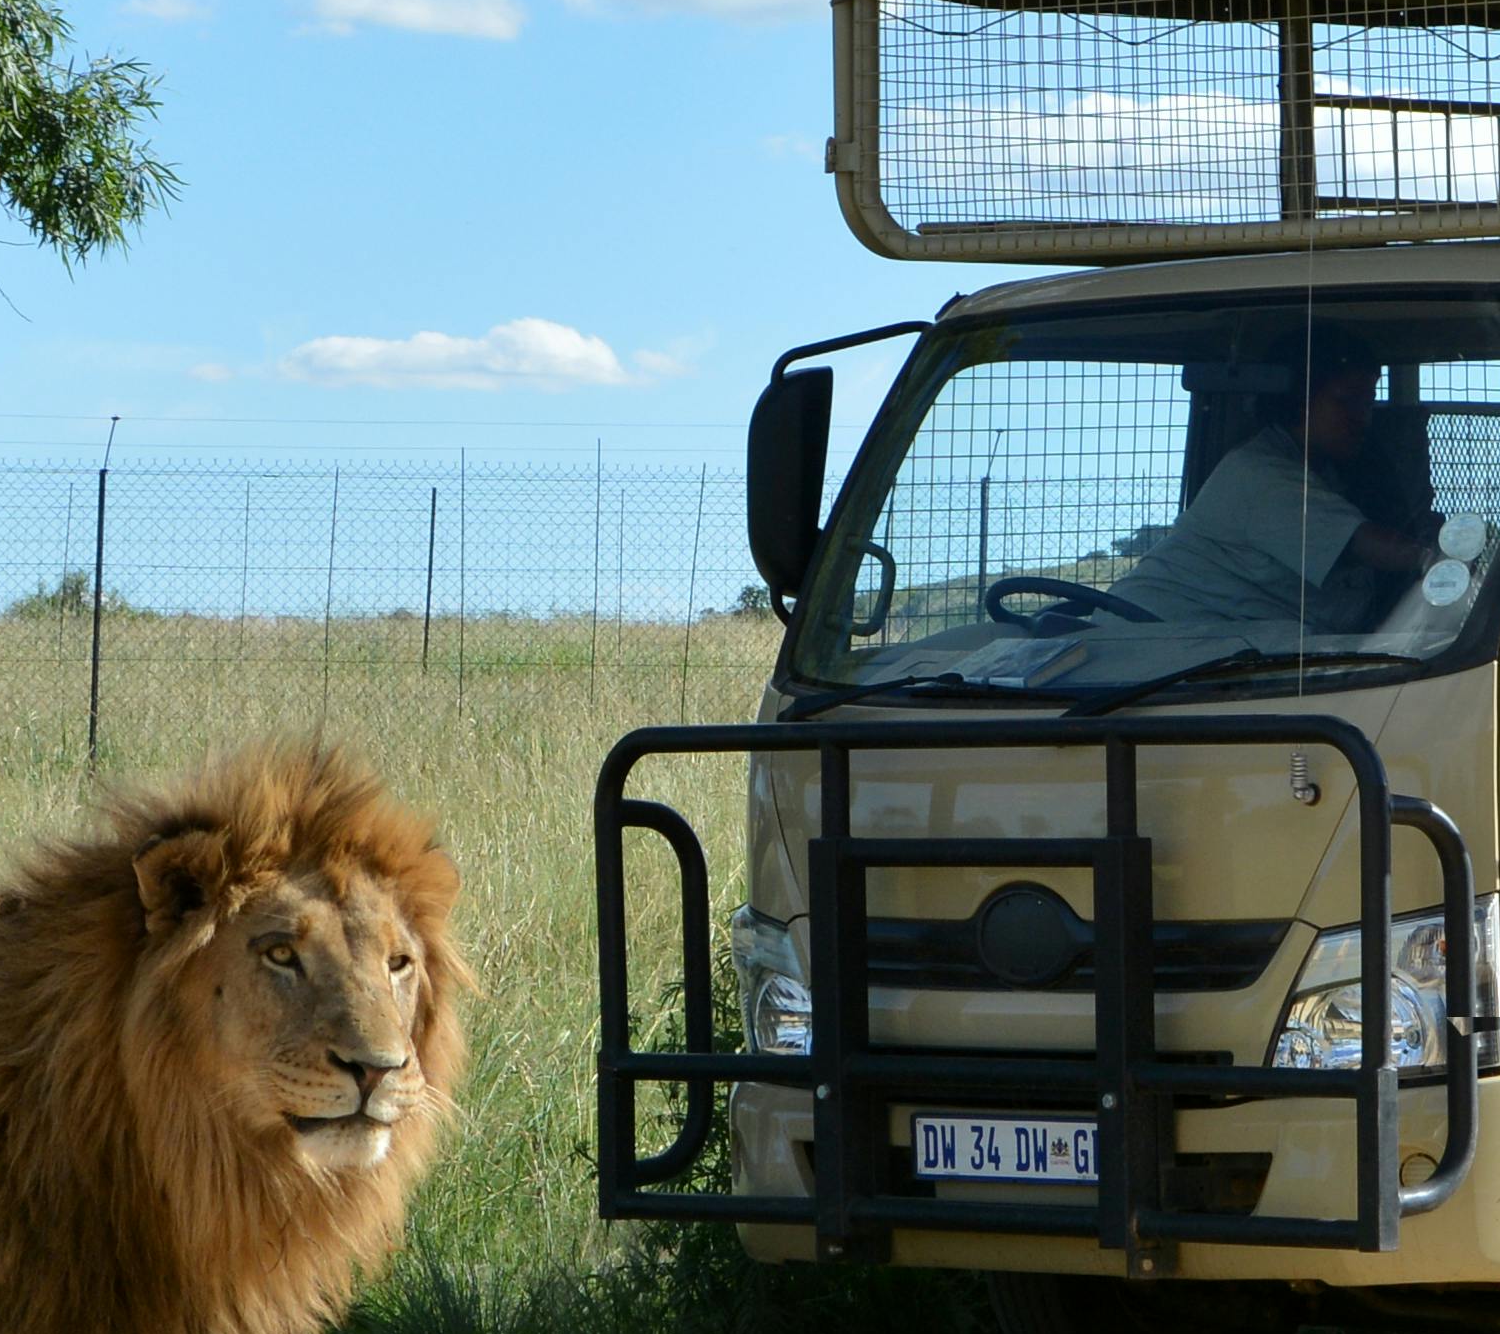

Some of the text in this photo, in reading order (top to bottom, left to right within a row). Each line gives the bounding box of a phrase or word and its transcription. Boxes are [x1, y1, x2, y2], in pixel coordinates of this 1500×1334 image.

[923, 1124, 956, 1170] DW
[970, 1126, 1000, 1171] 34
[1014, 1127, 1048, 1173] DW
